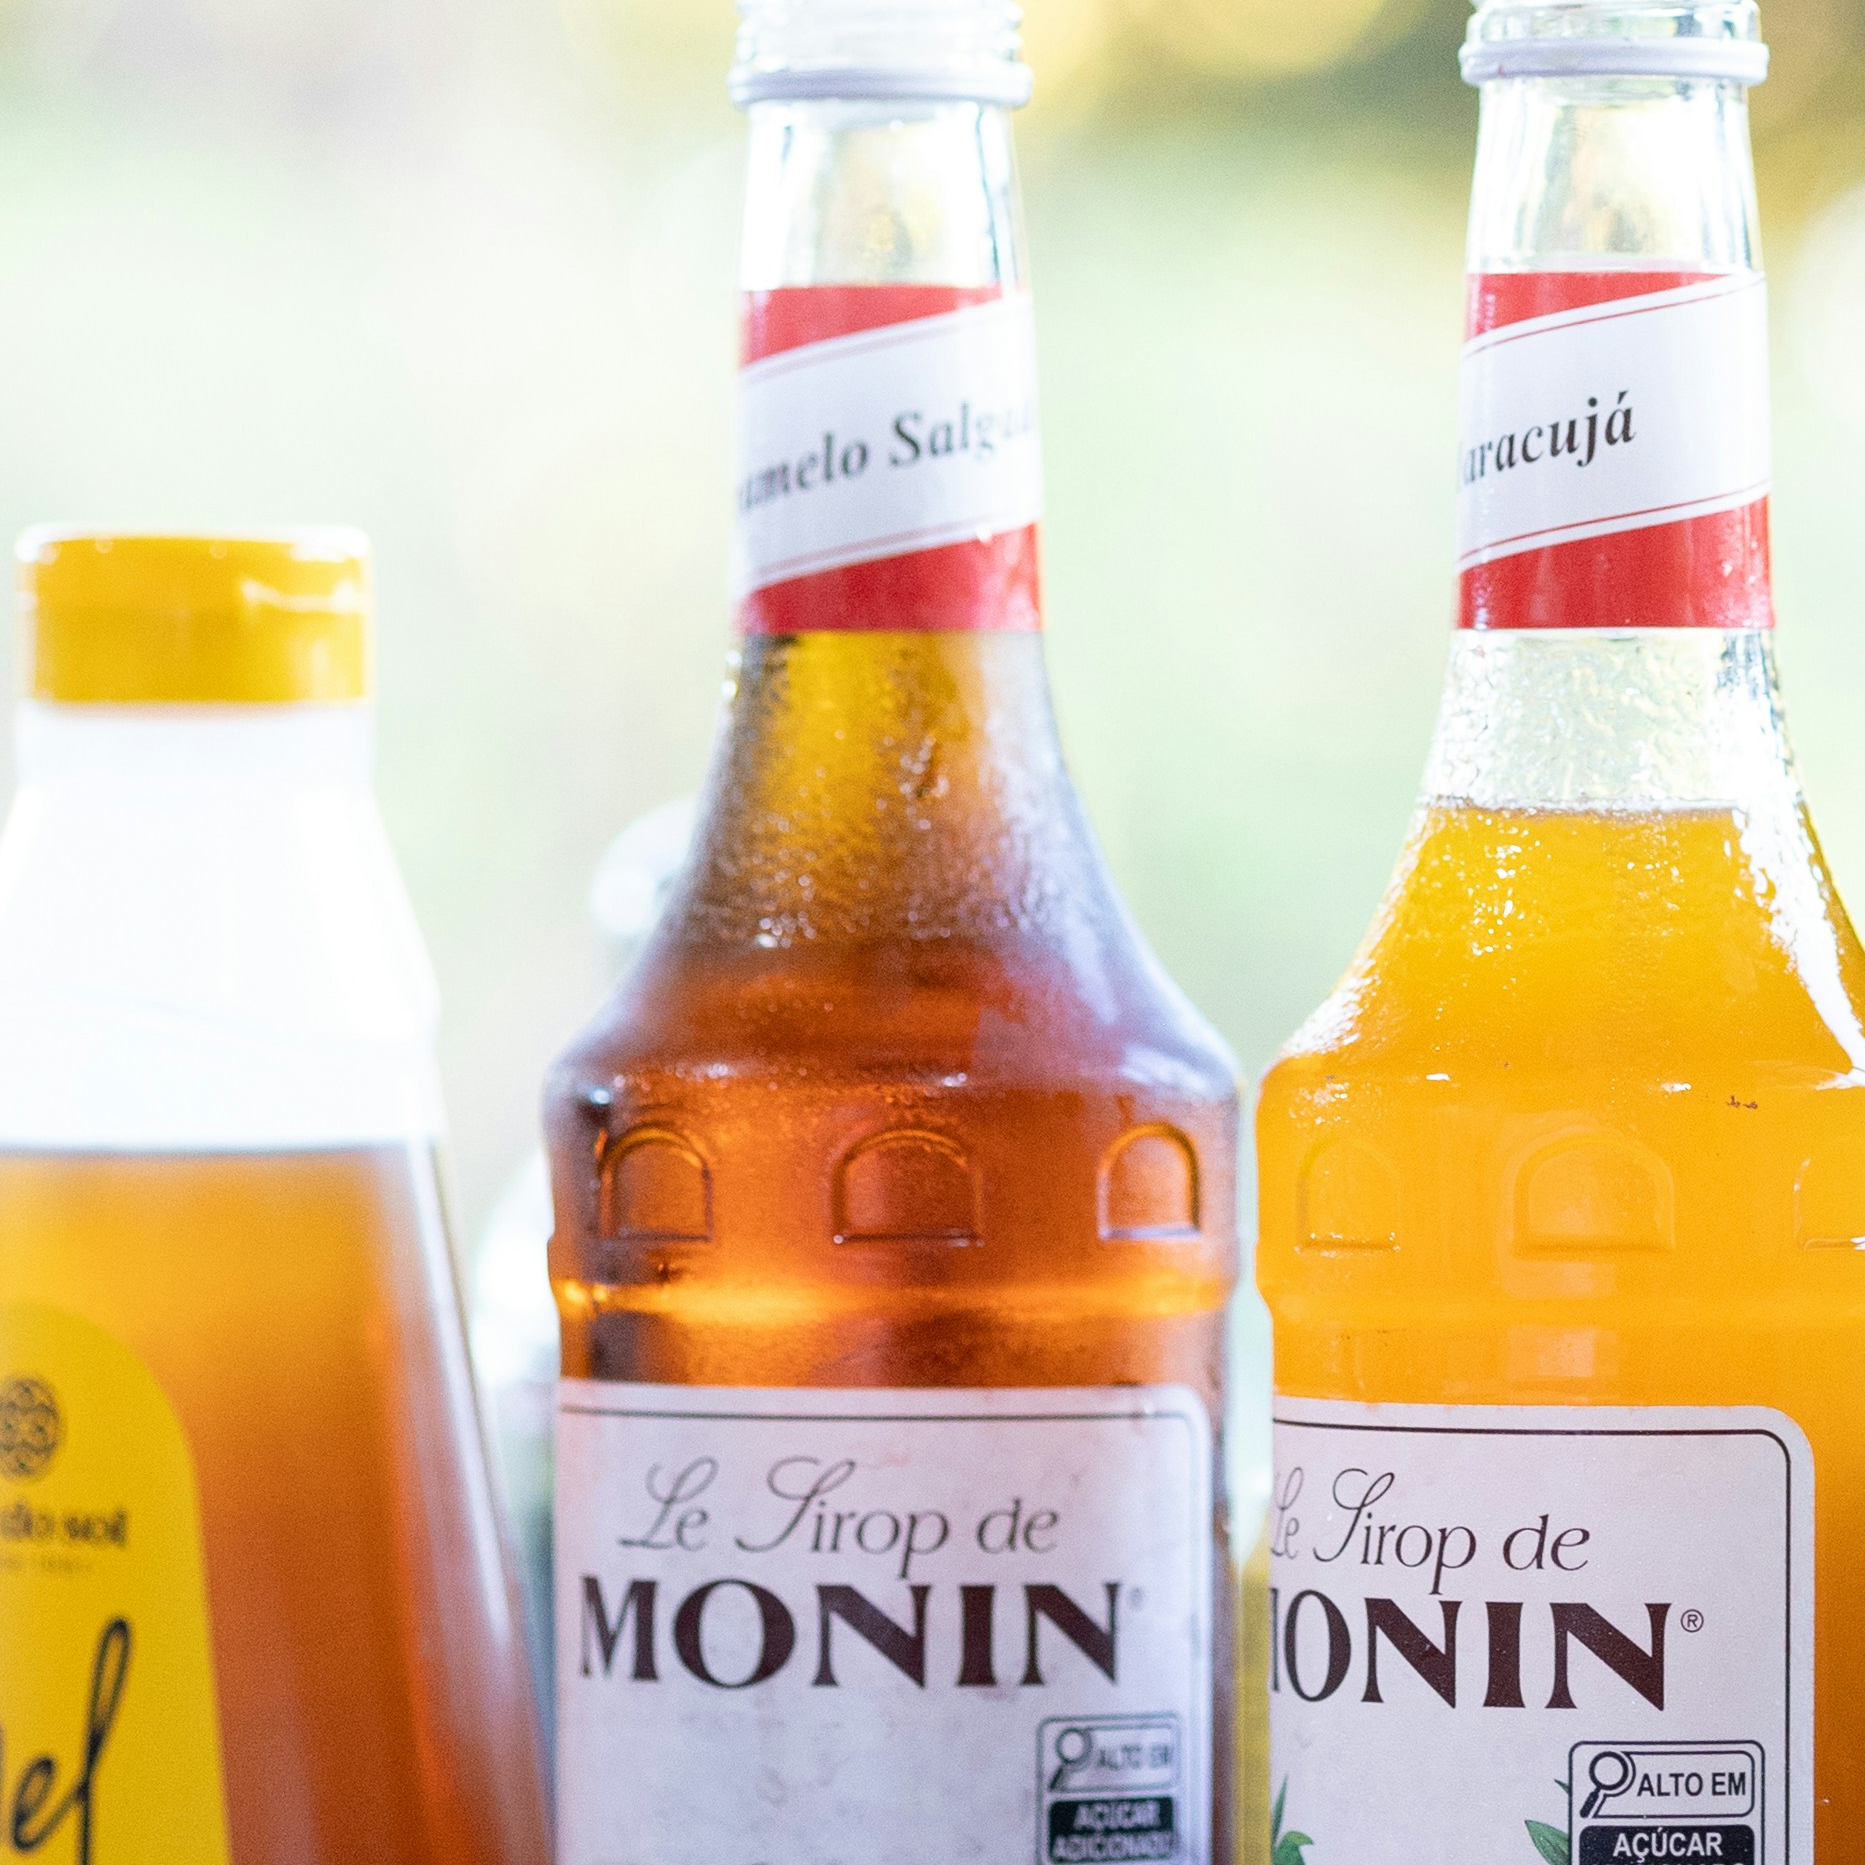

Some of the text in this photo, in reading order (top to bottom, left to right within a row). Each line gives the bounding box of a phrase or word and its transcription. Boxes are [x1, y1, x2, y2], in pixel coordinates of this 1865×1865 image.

[1463, 389, 1637, 485] aracujá
[619, 1455, 1061, 1580] Le Sirop de
[1312, 1467, 1477, 1596] Sirop
[1501, 1513, 1591, 1572] de
[1637, 1769, 1747, 1798] ALTO EM
[1612, 1824, 1723, 1864] AÇÚCAR
